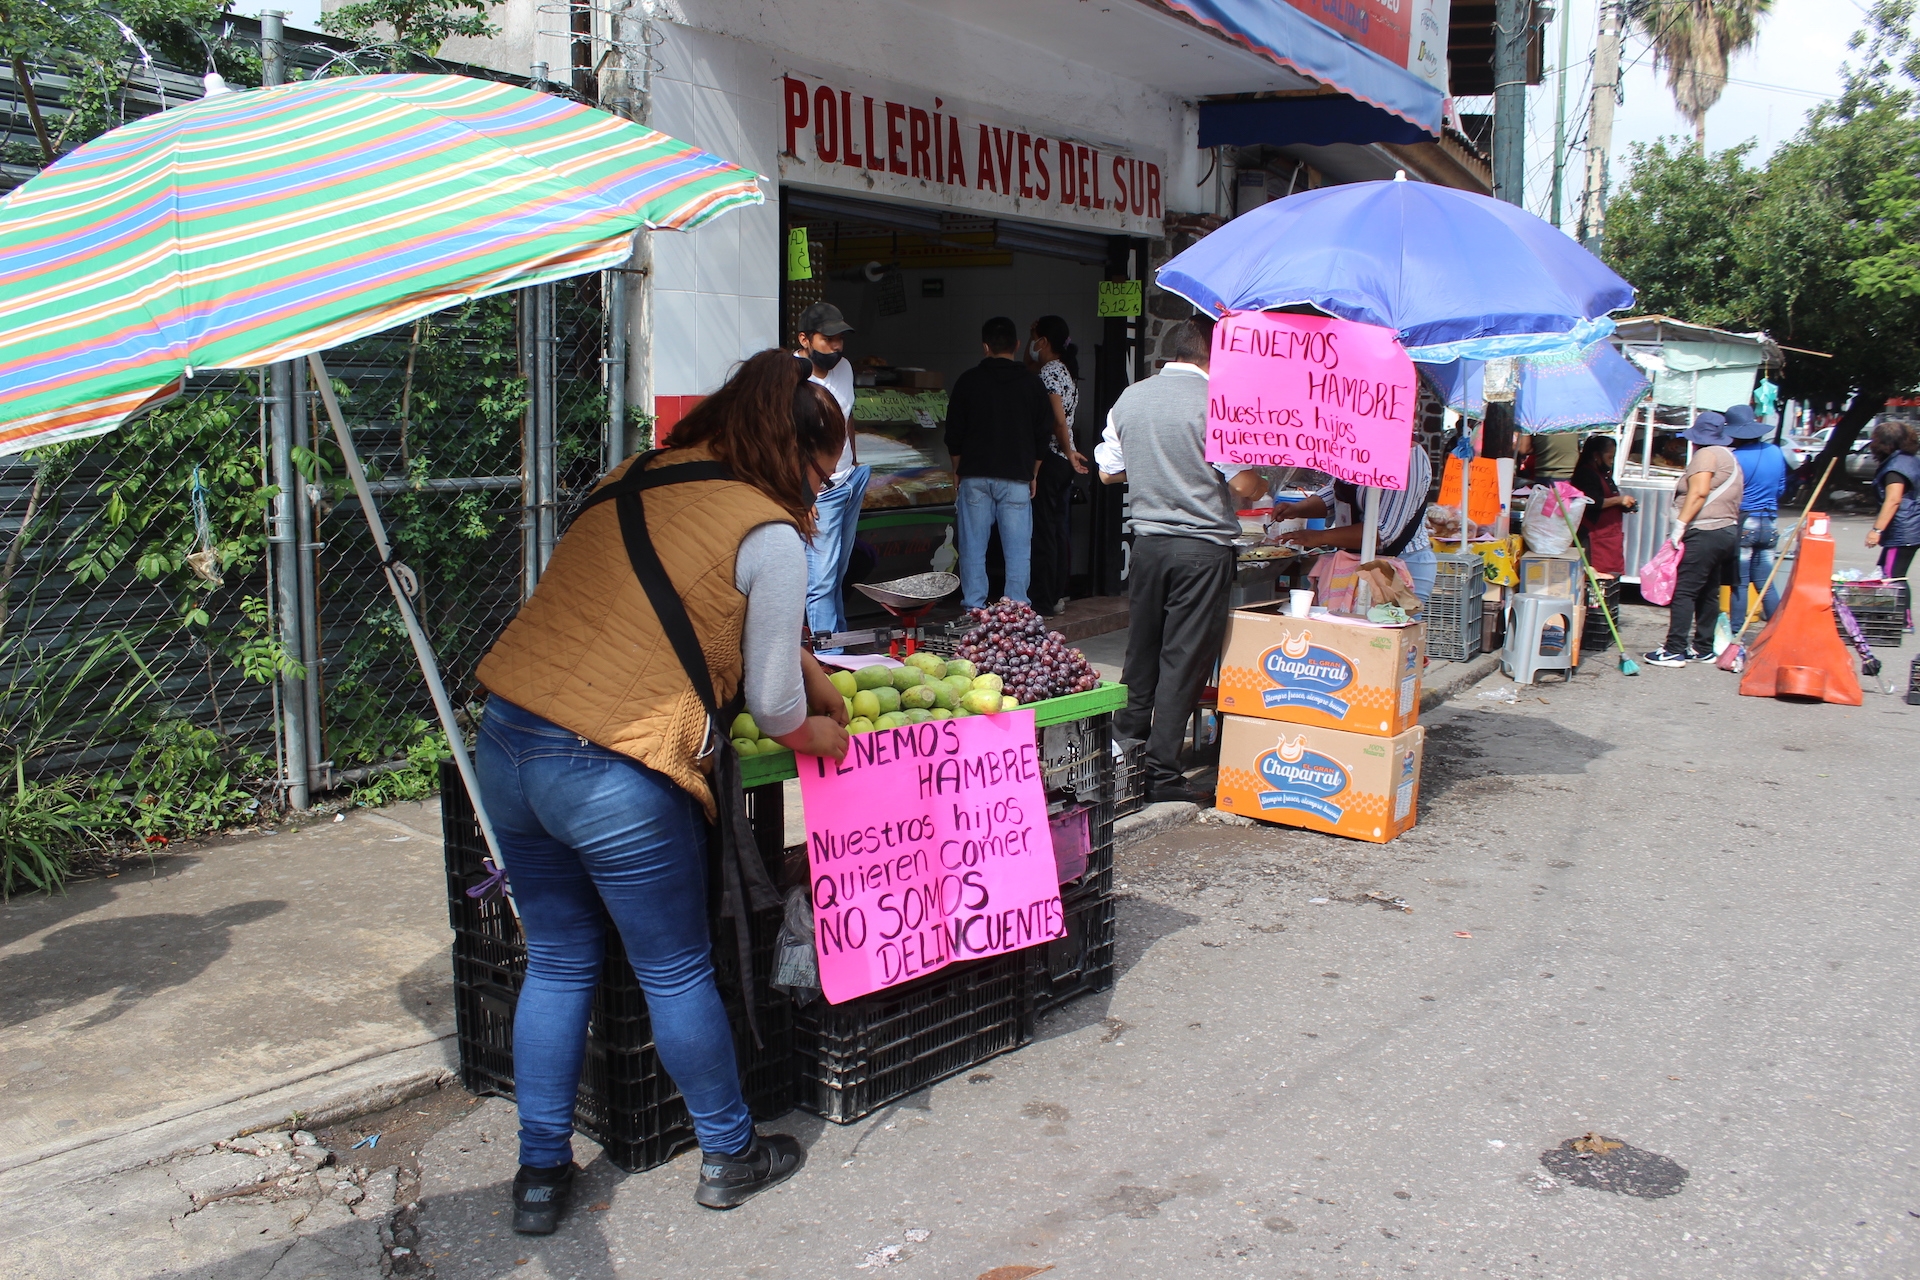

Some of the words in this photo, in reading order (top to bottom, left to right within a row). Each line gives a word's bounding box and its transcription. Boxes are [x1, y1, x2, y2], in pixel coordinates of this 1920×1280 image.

[783, 74, 967, 187] POLLERÍA
[977, 123, 1051, 201] AVES
[1058, 140, 1105, 211] DEL
[1112, 155, 1162, 219] SUR
[1100, 281, 1142, 296] CABEZA
[1308, 371, 1408, 423] HAMBRE
[1210, 394, 1304, 429] Nuestros
[1315, 406, 1356, 444] hijos
[1212, 428, 1290, 455] quieren
[1295, 433, 1348, 459] comer
[1349, 446, 1371, 464] no
[1229, 450, 1296, 467] somos
[1306, 453, 1401, 490] delincuentes
[1267, 654, 1348, 681] Chaparral
[1319, 660, 1341, 668] GRAN
[1265, 693, 1287, 703] Siempre
[1263, 757, 1342, 786] Chaparral
[1313, 765, 1335, 773] GRAN
[812, 814, 935, 865] Nuestros
[953, 797, 1024, 840] hijos
[813, 849, 929, 910] Quieren
[819, 906, 867, 956] NO
[877, 870, 989, 941] SOMOS
[876, 895, 1065, 985] DELINCUENTES
[524, 1186, 553, 1203] NIKE
